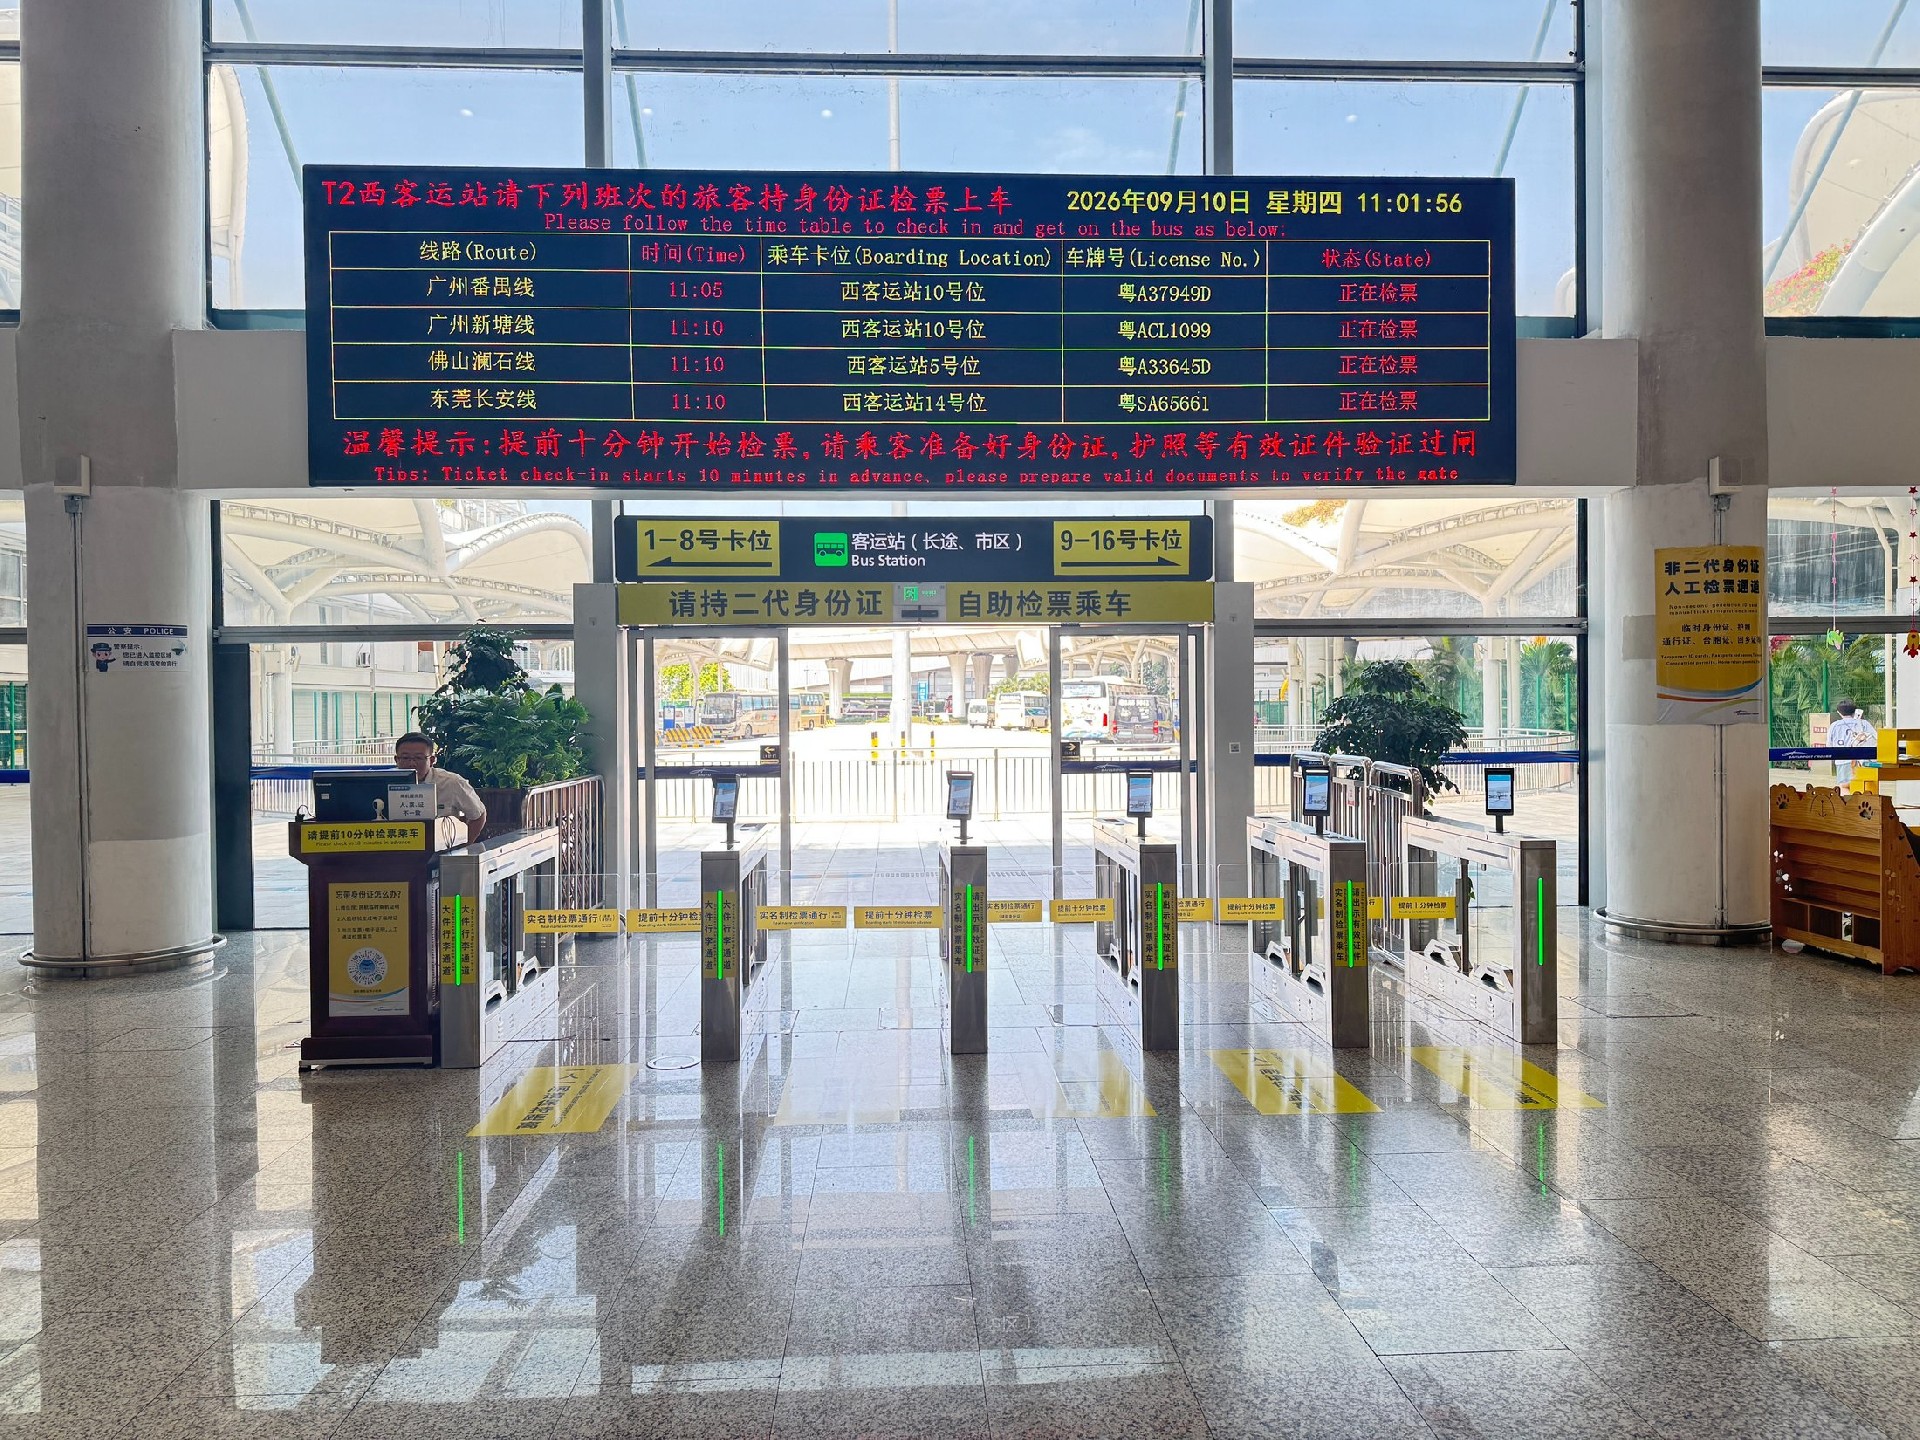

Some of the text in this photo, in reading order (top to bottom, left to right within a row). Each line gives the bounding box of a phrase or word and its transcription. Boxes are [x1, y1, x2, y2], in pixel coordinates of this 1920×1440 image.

[321, 180, 1013, 217] T2西客运站请下列班次的旅客持身份证检票上车
[1066, 190, 1463, 215] 2026年09月10日 星期四 11:01:56
[545, 214, 611, 230] Please
[623, 216, 689, 232] follow
[701, 218, 732, 232] the
[799, 218, 850, 234] table
[864, 220, 885, 234] to
[896, 219, 948, 235] check
[961, 221, 982, 235] in
[993, 220, 1023, 235] and
[1034, 223, 1066, 240] get
[1078, 224, 1100, 236] on
[1110, 221, 1140, 236] the
[1151, 221, 1183, 237] bus
[1194, 225, 1215, 237] as
[1226, 221, 1287, 237] below:
[420, 241, 537, 263] 线路(Route)
[641, 244, 746, 265] 时间(Time)
[767, 245, 1053, 270] 乘车卡位(Boarding Location)
[1066, 248, 1261, 271] 车牌号(License No.)
[1321, 249, 1432, 271] 状态(State)
[427, 276, 535, 298] 广州番禺线
[669, 281, 724, 298] 11:05
[840, 281, 986, 303] 西客运站10号位
[1118, 283, 1212, 305] 粤A37949D
[1338, 283, 1419, 303] 正在检票
[427, 313, 535, 335] 广州新塘线
[669, 319, 724, 336] 11:10
[841, 319, 987, 340] 西客运站10号位
[1118, 319, 1212, 341] 粤ACL1099
[1338, 319, 1419, 339] 正在检票
[427, 350, 536, 371] 佛山澜石线
[671, 355, 726, 372] 11:10
[847, 355, 982, 377] 西客运站5号位
[1118, 355, 1212, 377] 粤A33645D
[1338, 355, 1419, 375] 正在检票
[429, 388, 537, 410] 东莞长安线
[671, 393, 726, 410] 11:10
[842, 393, 988, 414] 西客运站14号位
[1118, 393, 1211, 413] 粤SA65661
[1338, 391, 1419, 411] 正在检票
[374, 466, 429, 483] Tips:
[441, 466, 508, 482] Ticket
[520, 467, 609, 482] check-in
[622, 469, 686, 483] starts
[699, 469, 720, 482] 10
[731, 469, 807, 484] minutes
[819, 471, 837, 483] in
[945, 468, 1009, 485] please
[1020, 471, 1091, 485] prepare
[1103, 469, 1154, 483] valid
[1165, 469, 1260, 483] documents
[1272, 470, 1290, 482] to
[1302, 467, 1364, 483] verify
[1417, 468, 1458, 482] gate
[851, 532, 1025, 554] 客运站（长途、市区）
[851, 554, 926, 568] Bus Station
[1664, 558, 1760, 576] 非二代身份证
[1664, 578, 1760, 597] 人工检票通道
[668, 588, 883, 619] 请持二代身份证
[958, 589, 1133, 619] 自助检票乘车
[108, 627, 132, 635] 公安
[307, 828, 419, 841] 请提前10分钟检票乘车
[527, 913, 598, 924] 实名制检票通行
[638, 911, 702, 923] 提前十分钟检
[759, 910, 828, 920] 实名制检票通行
[864, 910, 933, 920] 提前十分钟检票
[442, 904, 451, 976] 大件行李通道
[461, 904, 470, 976] 大件行李通道
[705, 900, 713, 970] 大件行李通道
[723, 900, 731, 970] 大件行李通道
